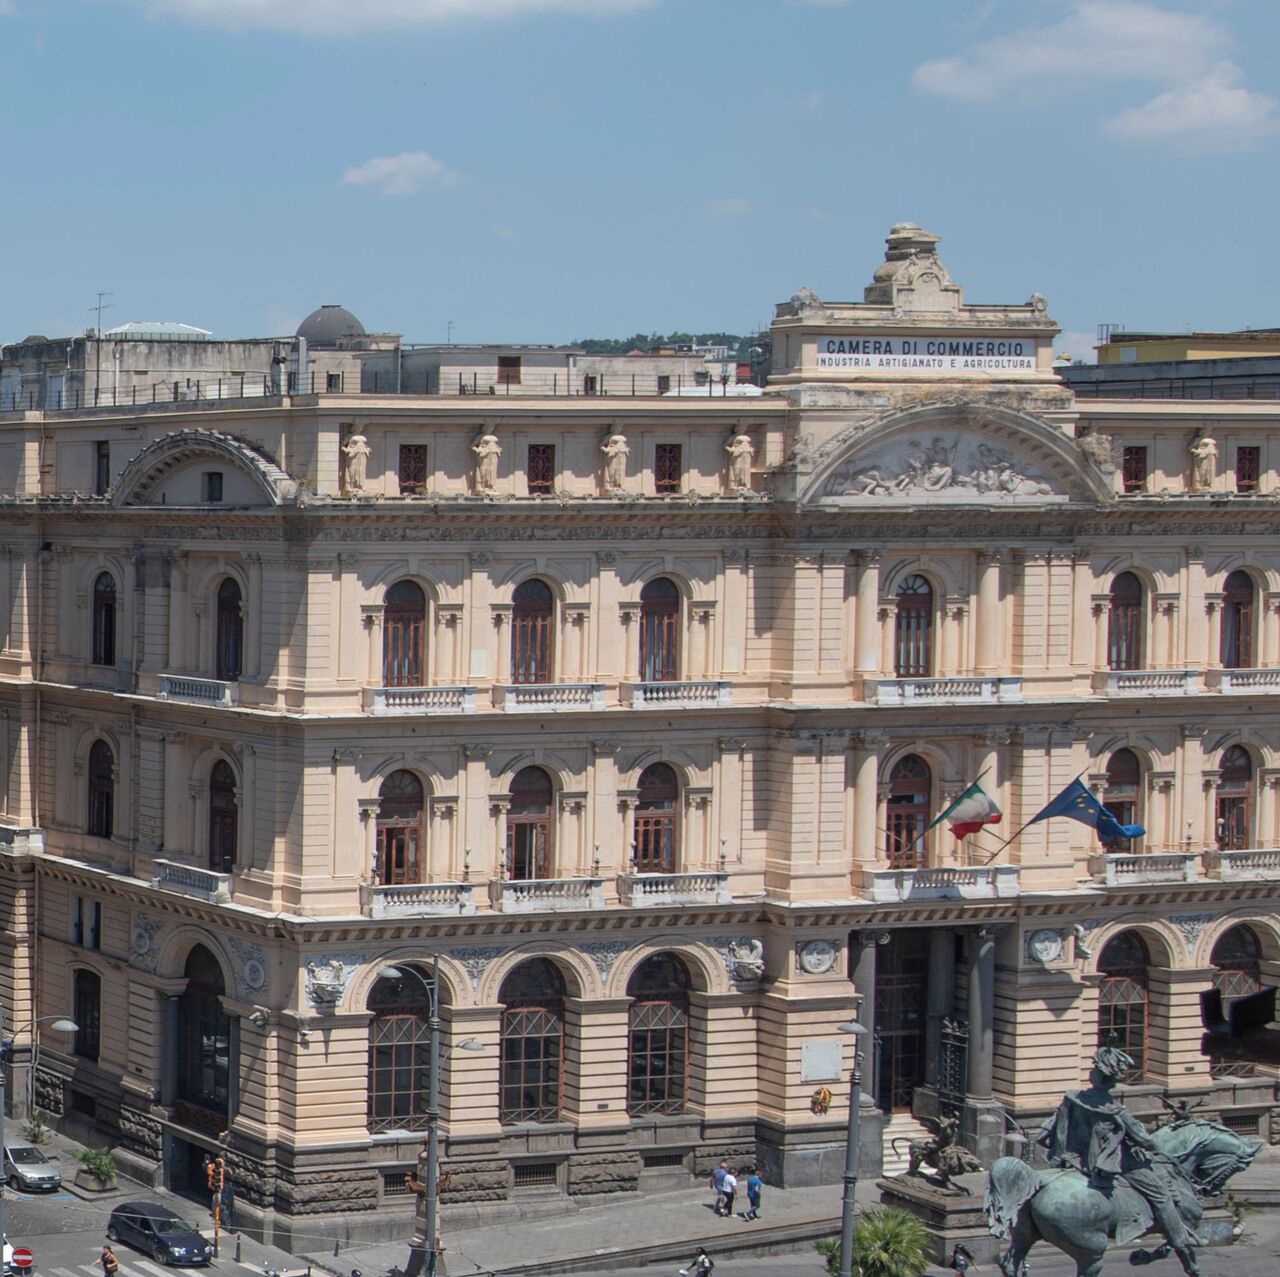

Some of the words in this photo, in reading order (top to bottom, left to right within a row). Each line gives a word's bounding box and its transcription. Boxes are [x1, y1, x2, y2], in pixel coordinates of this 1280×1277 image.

[826, 340, 893, 355] CAMERA
[902, 341, 917, 355] DI
[926, 341, 1023, 356] COMMERCIO
[816, 357, 871, 368] INDUSTRIA
[878, 358, 943, 368] ARTIGIANATO
[950, 359, 955, 368] E
[963, 358, 1031, 369] AGRICOLTURA
